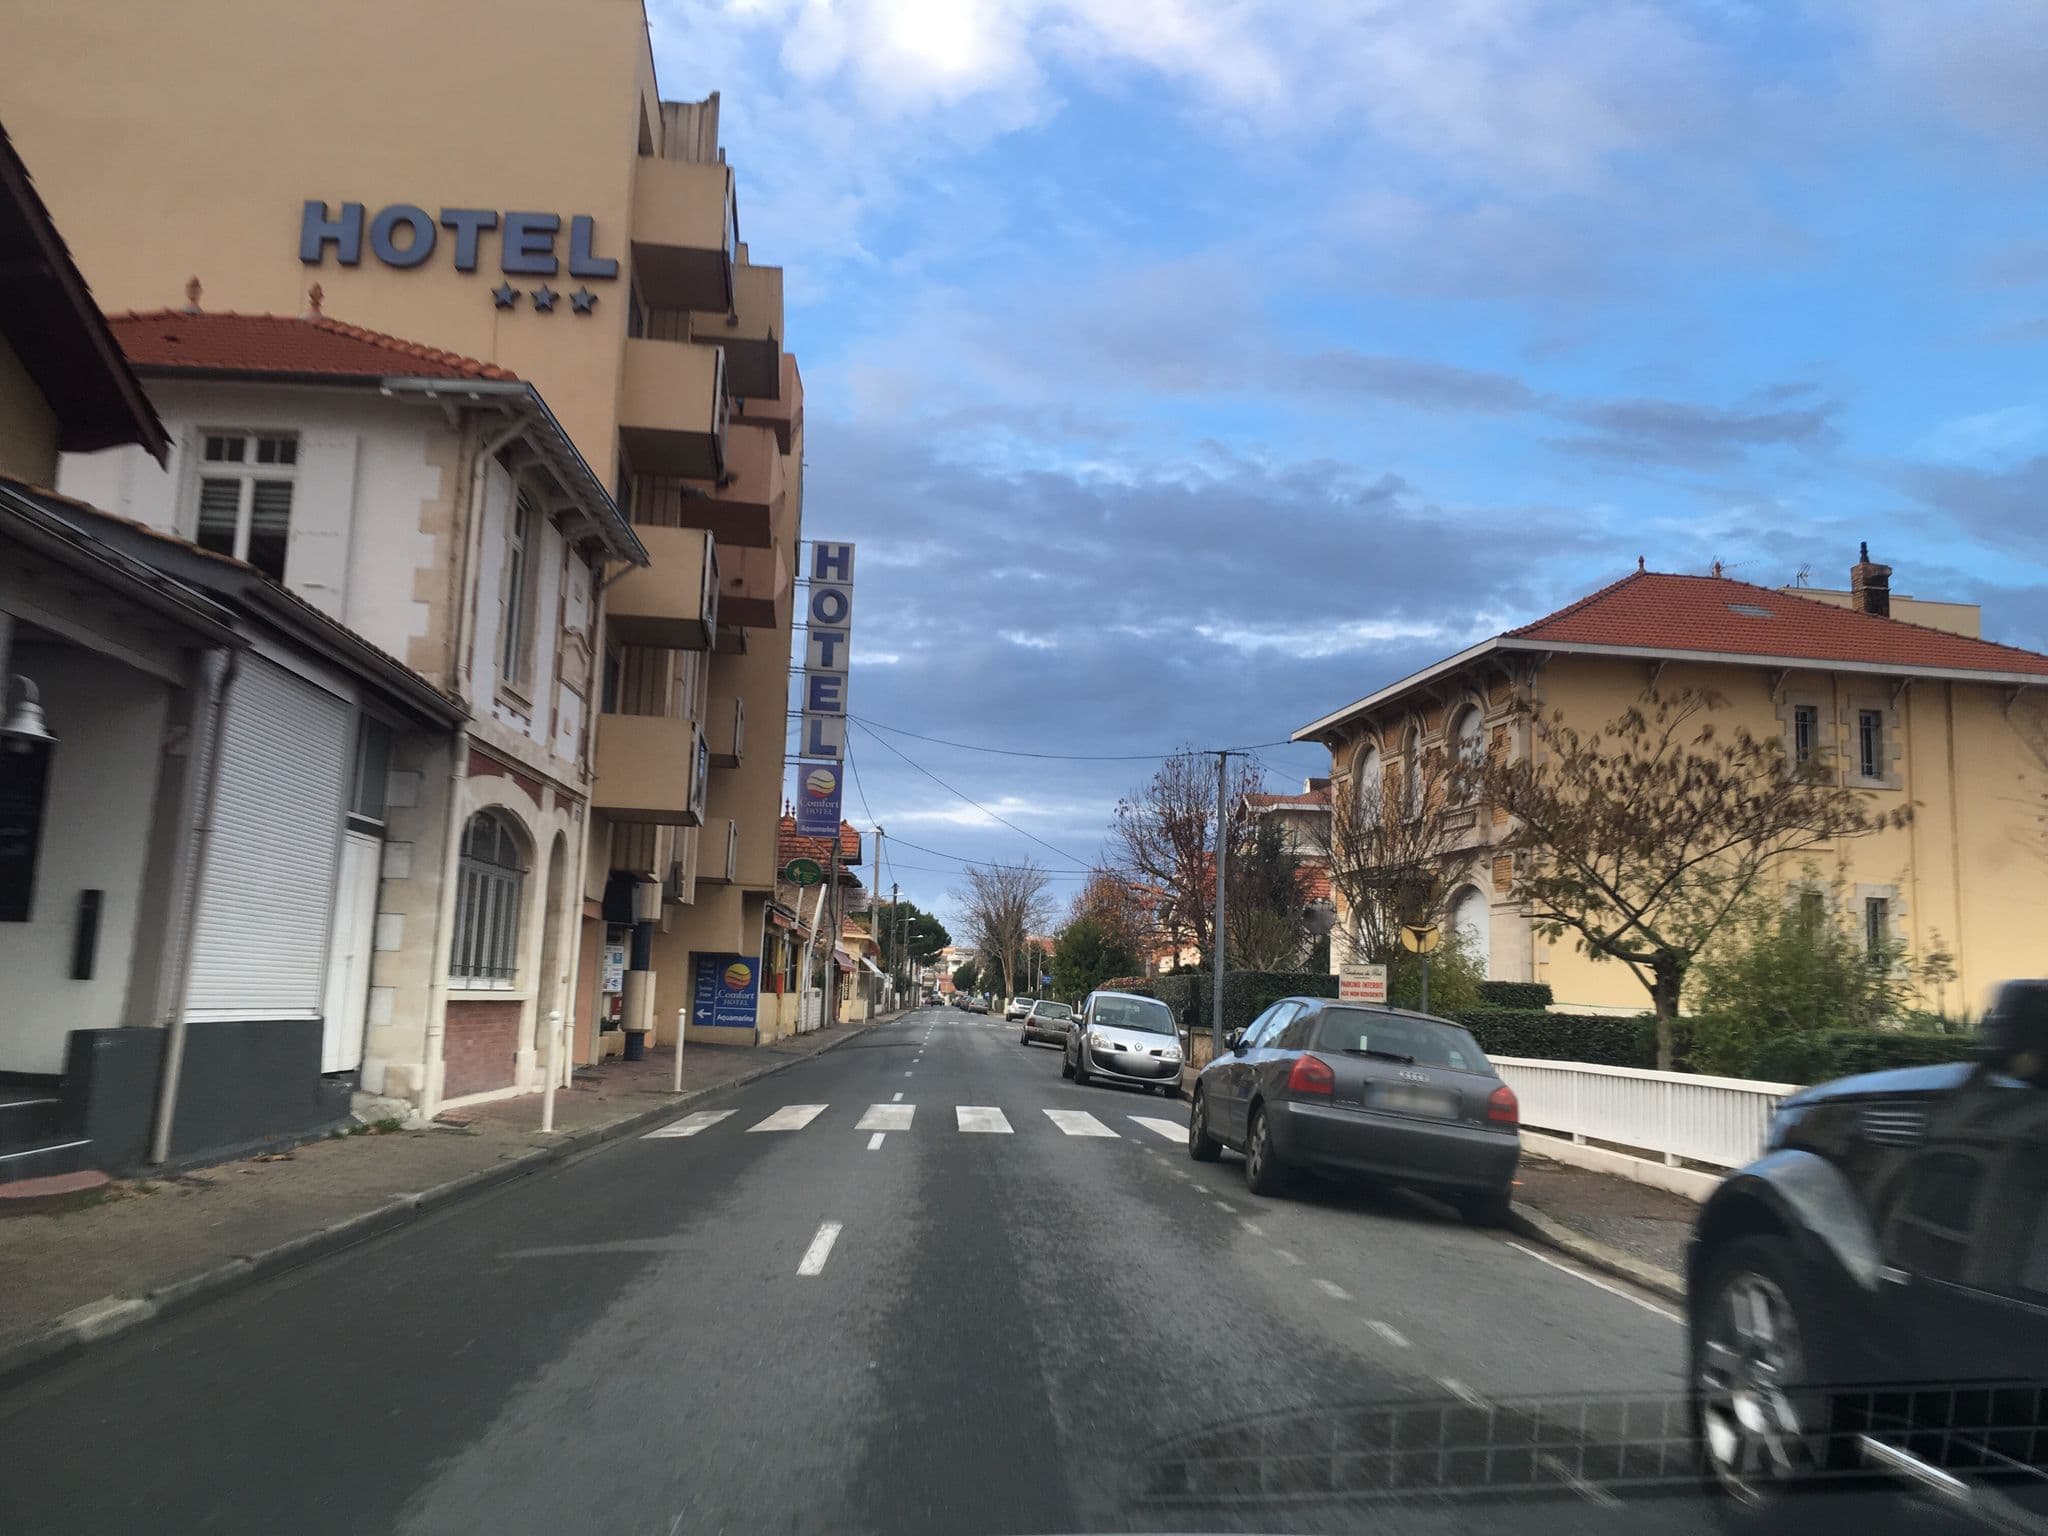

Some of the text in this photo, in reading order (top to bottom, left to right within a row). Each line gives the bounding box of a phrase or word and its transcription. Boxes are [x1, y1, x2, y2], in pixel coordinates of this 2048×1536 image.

[299, 200, 619, 280] HOTEL
[809, 543, 850, 757] HOTEL
[800, 798, 840, 809] Comfort
[717, 989, 754, 999] Comfort
